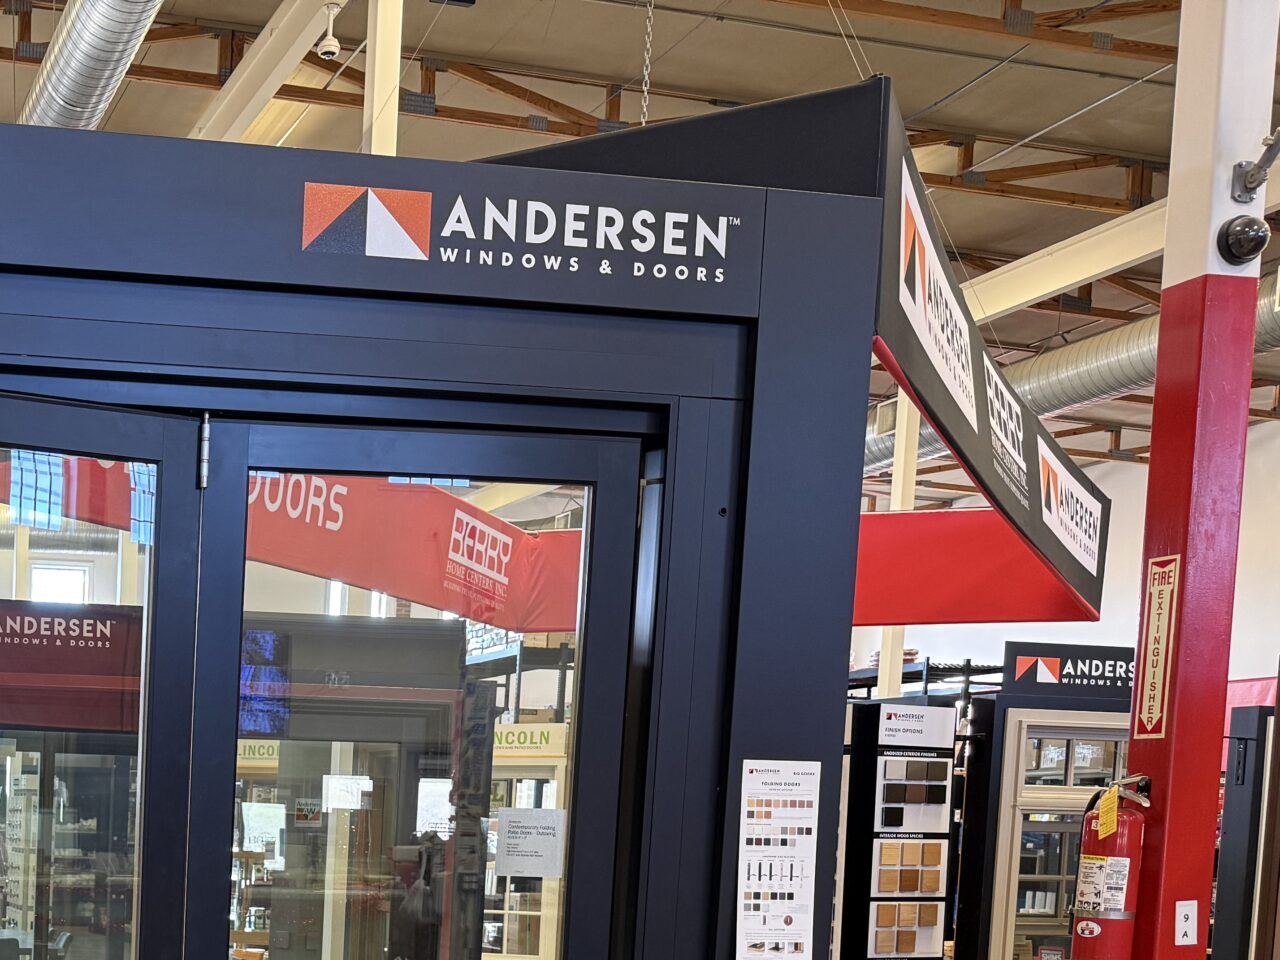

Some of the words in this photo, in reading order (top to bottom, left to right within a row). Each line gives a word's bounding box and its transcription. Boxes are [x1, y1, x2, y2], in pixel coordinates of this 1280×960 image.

[440, 194, 728, 259] ANDERSEN
[439, 247, 579, 272] WINDOWS
[599, 259, 613, 275] &
[633, 262, 725, 283] DOORS
[927, 260, 972, 382] ANDERSEN
[1059, 479, 1099, 544] ANDERSEN
[448, 508, 513, 585] BERRY
[446, 560, 466, 579] HOME
[1151, 569, 1174, 588] FIRE
[70, 640, 111, 648] DOORS
[1146, 589, 1165, 727] EXTINGUISHER
[1061, 678, 1111, 686] WINDOWS
[1183, 913, 1190, 923] 9
[1181, 930, 1189, 939] A
